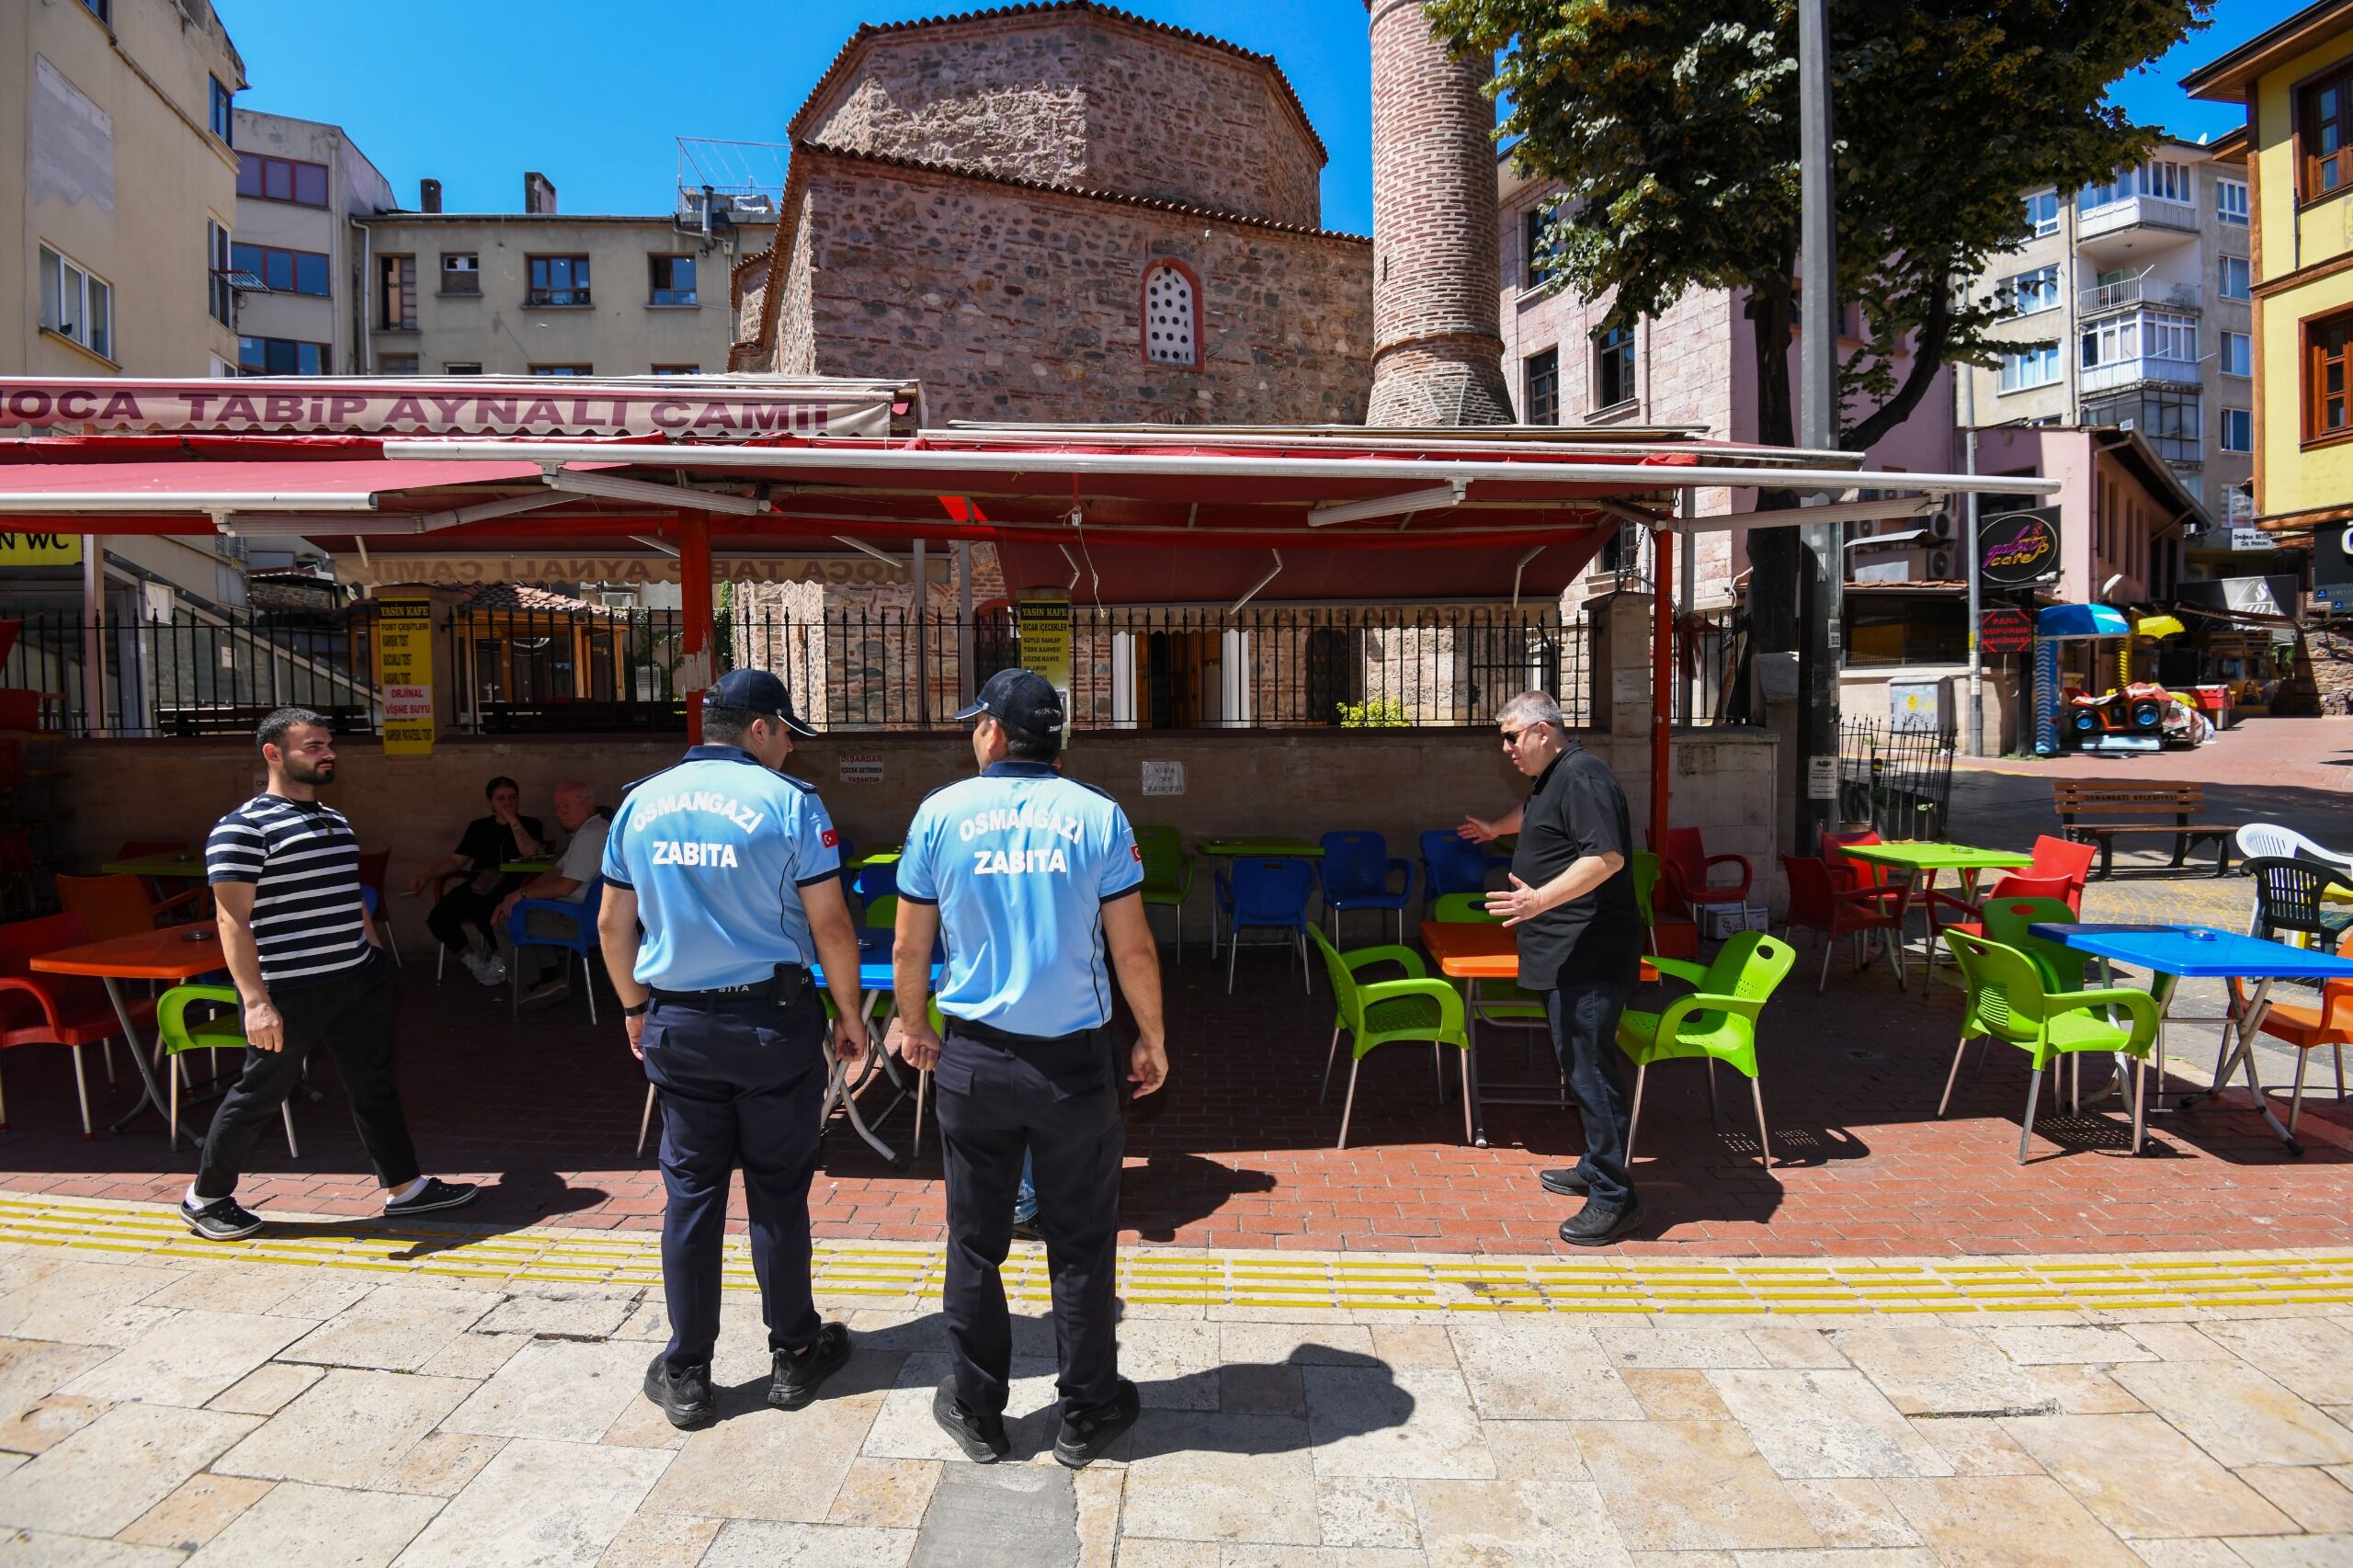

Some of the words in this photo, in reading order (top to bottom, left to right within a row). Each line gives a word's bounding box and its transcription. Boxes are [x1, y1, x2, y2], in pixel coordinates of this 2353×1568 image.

[0, 390, 143, 421] OCA
[385, 396, 627, 427] AYNALI
[26, 533, 70, 550] WC
[406, 607, 429, 616] KAFE
[1047, 608, 1066, 617] KAFE
[1022, 623, 1038, 631] SICAK
[391, 687, 423, 699] ORJİNAL
[385, 703, 408, 716] VİŞNE
[410, 705, 430, 714] SUYU
[652, 841, 738, 868] ZABITA
[973, 849, 1067, 875] ZABITA
